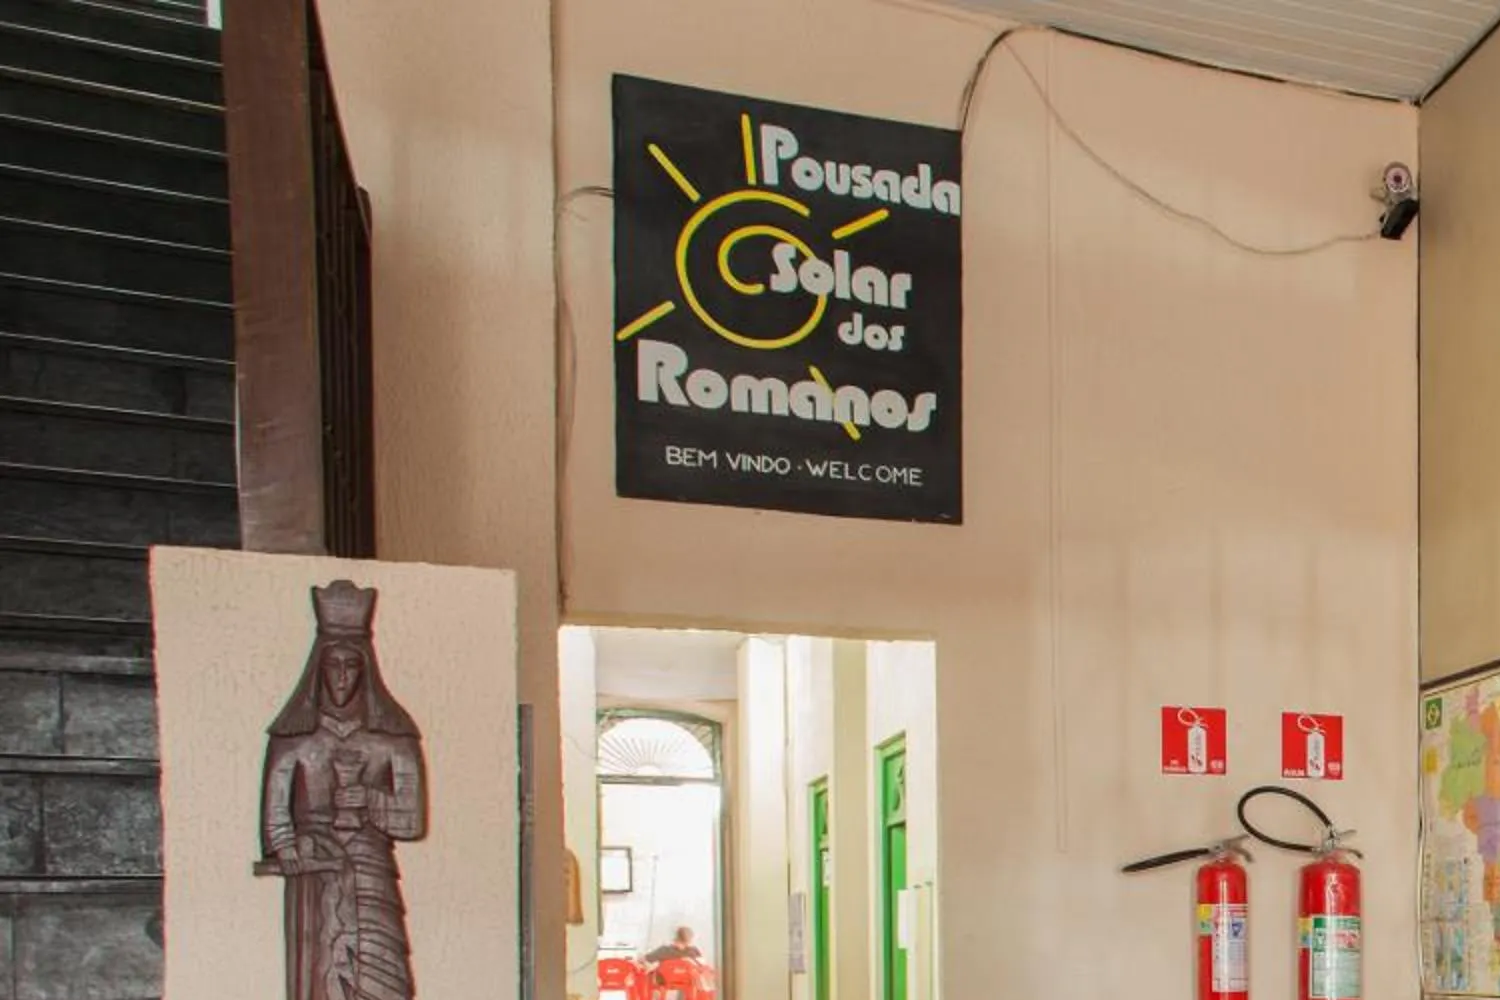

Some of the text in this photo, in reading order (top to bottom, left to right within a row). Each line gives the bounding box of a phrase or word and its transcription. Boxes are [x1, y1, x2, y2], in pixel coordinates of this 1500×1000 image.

[760, 123, 961, 216] Pousada
[770, 242, 912, 309] Solar
[838, 312, 905, 351] dos
[637, 338, 937, 432] Romanos
[665, 445, 923, 487] BEM VINDO WELCOME
